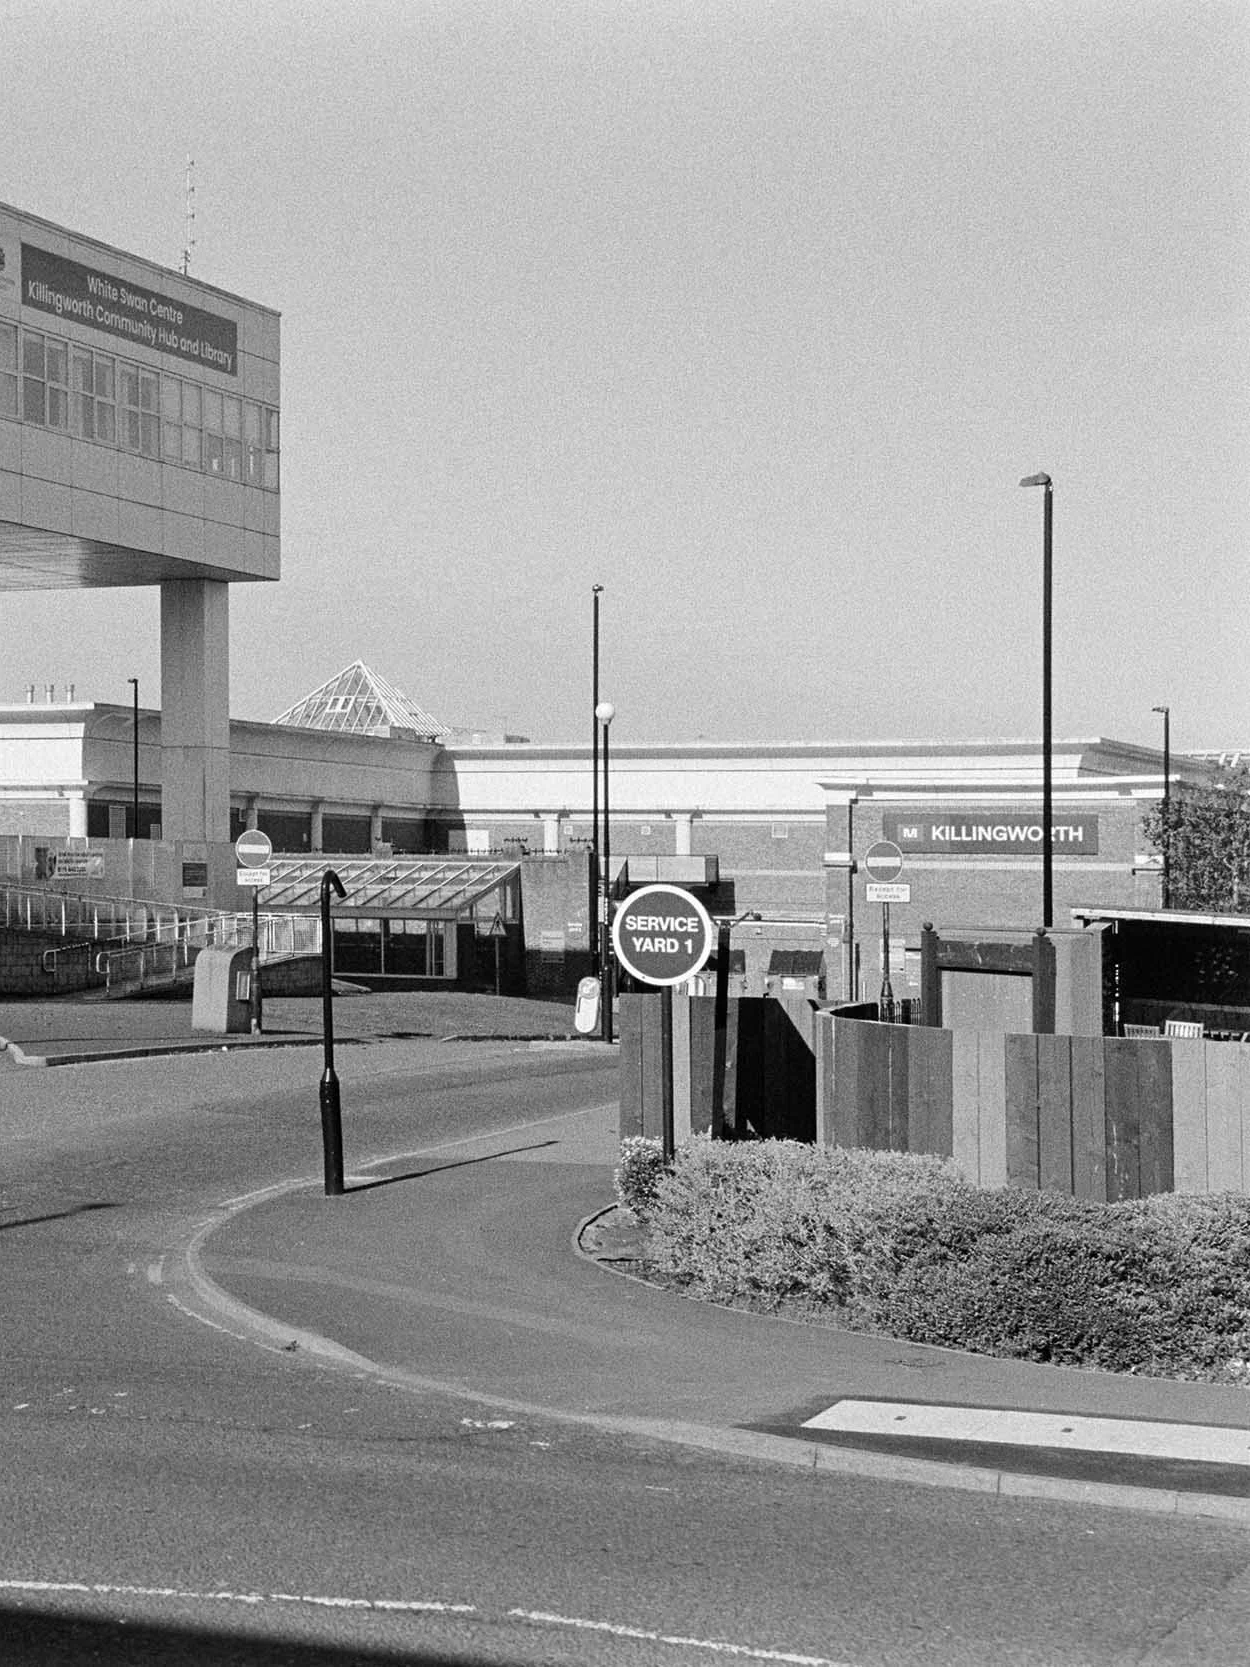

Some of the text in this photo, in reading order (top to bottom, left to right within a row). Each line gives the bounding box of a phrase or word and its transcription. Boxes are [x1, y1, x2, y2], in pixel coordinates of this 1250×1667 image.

[87, 275, 183, 325] White Swan Centre
[28, 280, 94, 320] Killingworth
[96, 305, 156, 346] Community
[159, 327, 178, 348] Hub
[180, 338, 199, 356] and
[200, 340, 231, 371] Library
[625, 915, 699, 932] SERVICE
[632, 937, 692, 954] YARD 1
